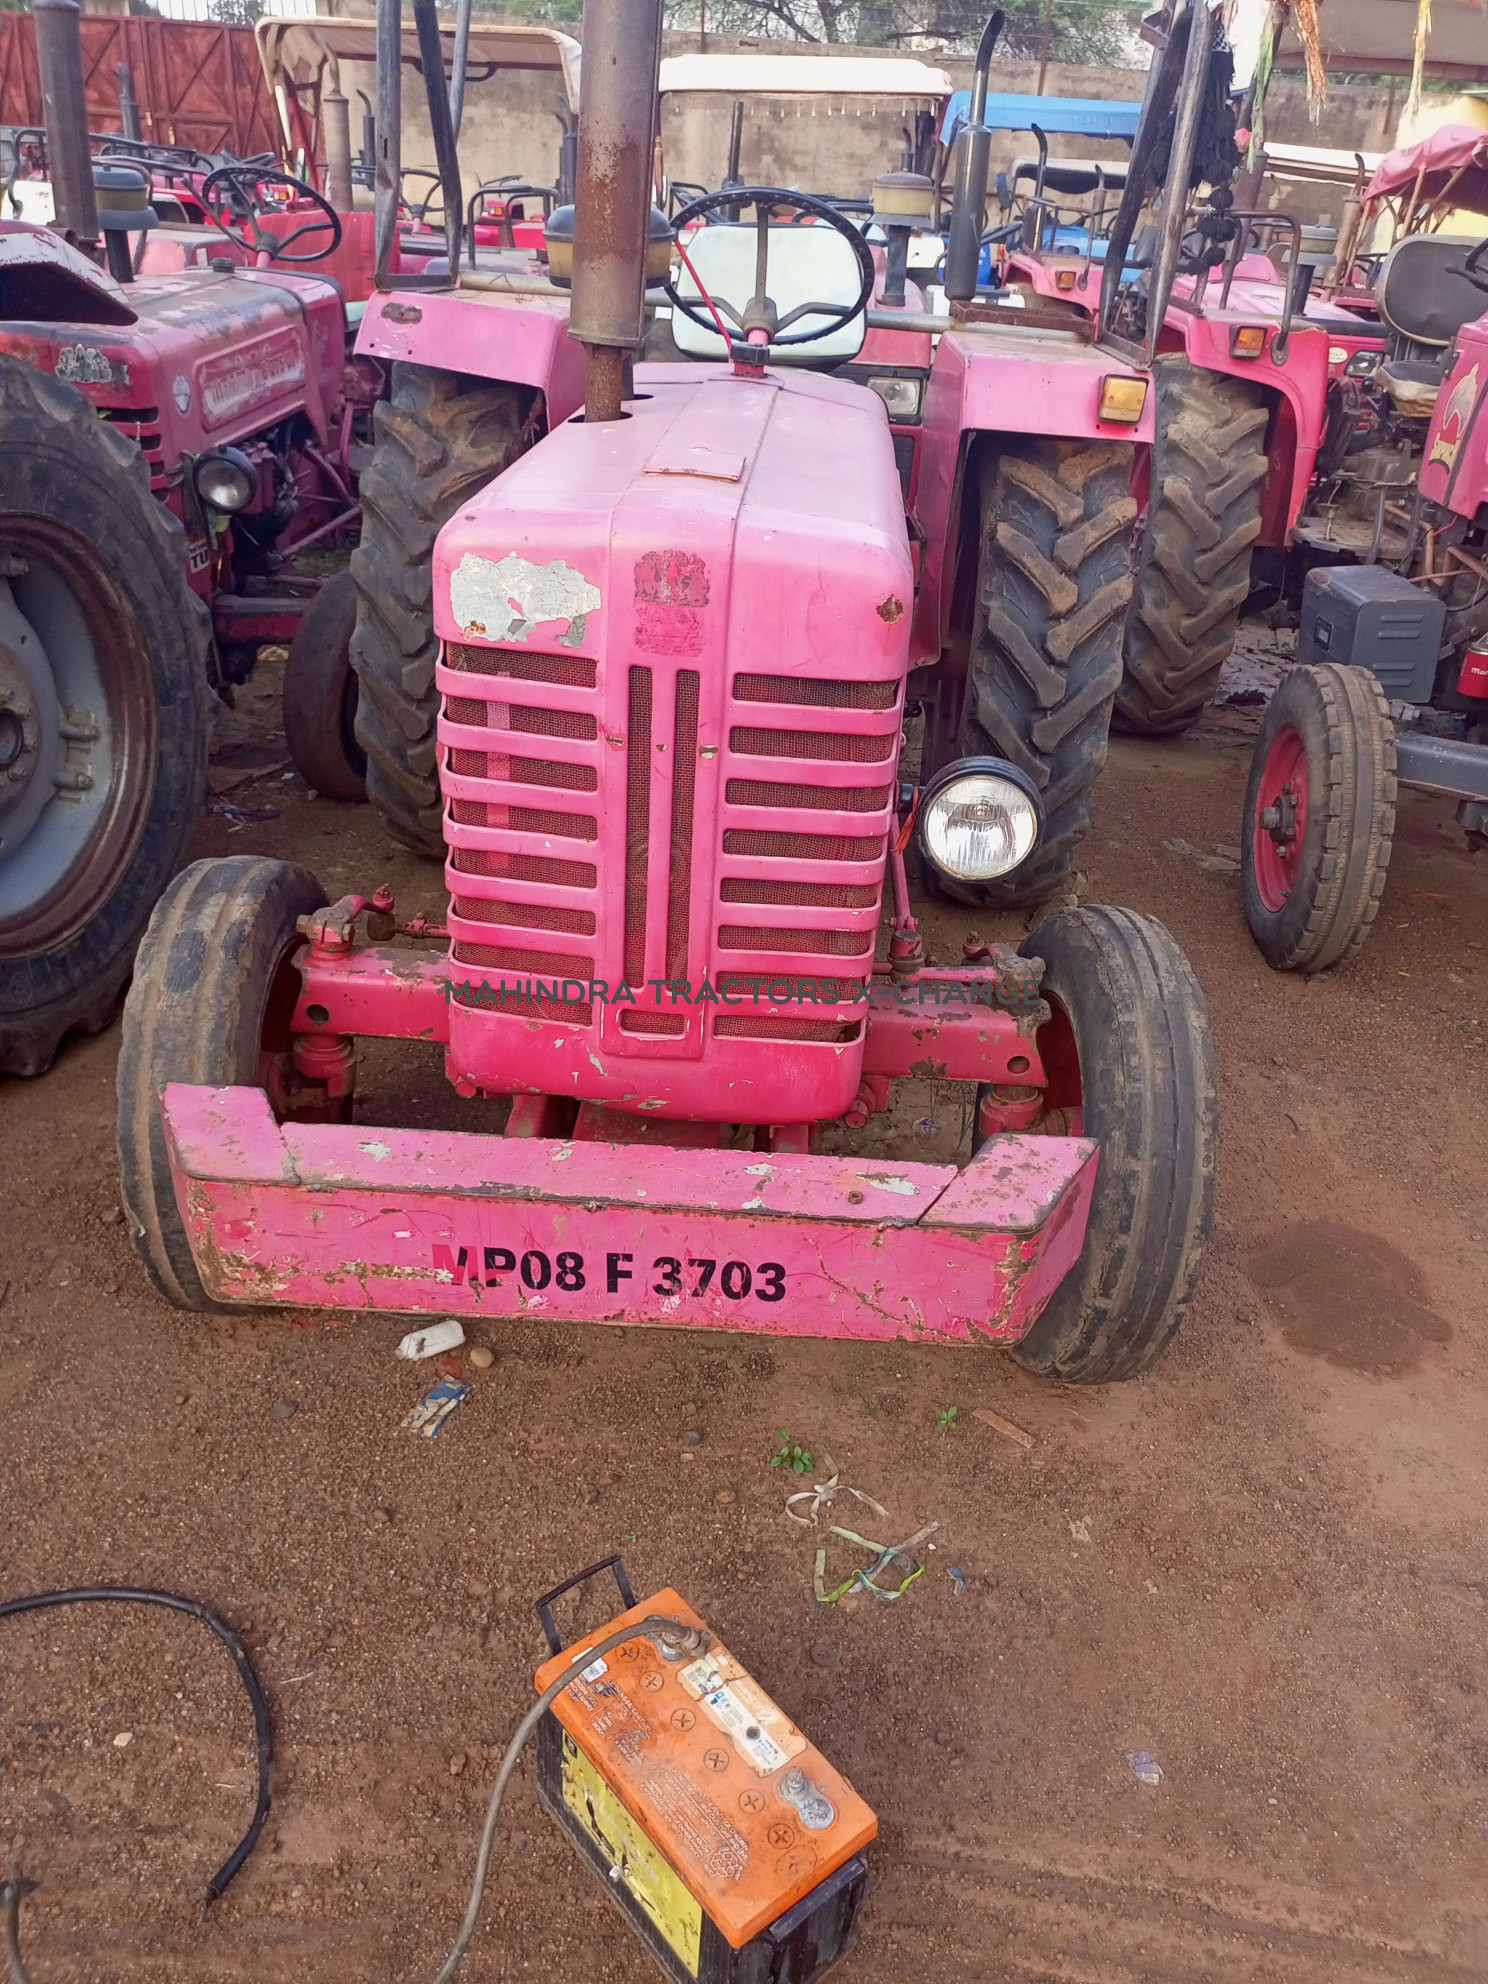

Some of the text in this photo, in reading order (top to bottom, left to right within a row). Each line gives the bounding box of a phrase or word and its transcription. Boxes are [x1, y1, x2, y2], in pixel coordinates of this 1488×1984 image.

[432, 1243, 787, 1302] MP08 F 3703
